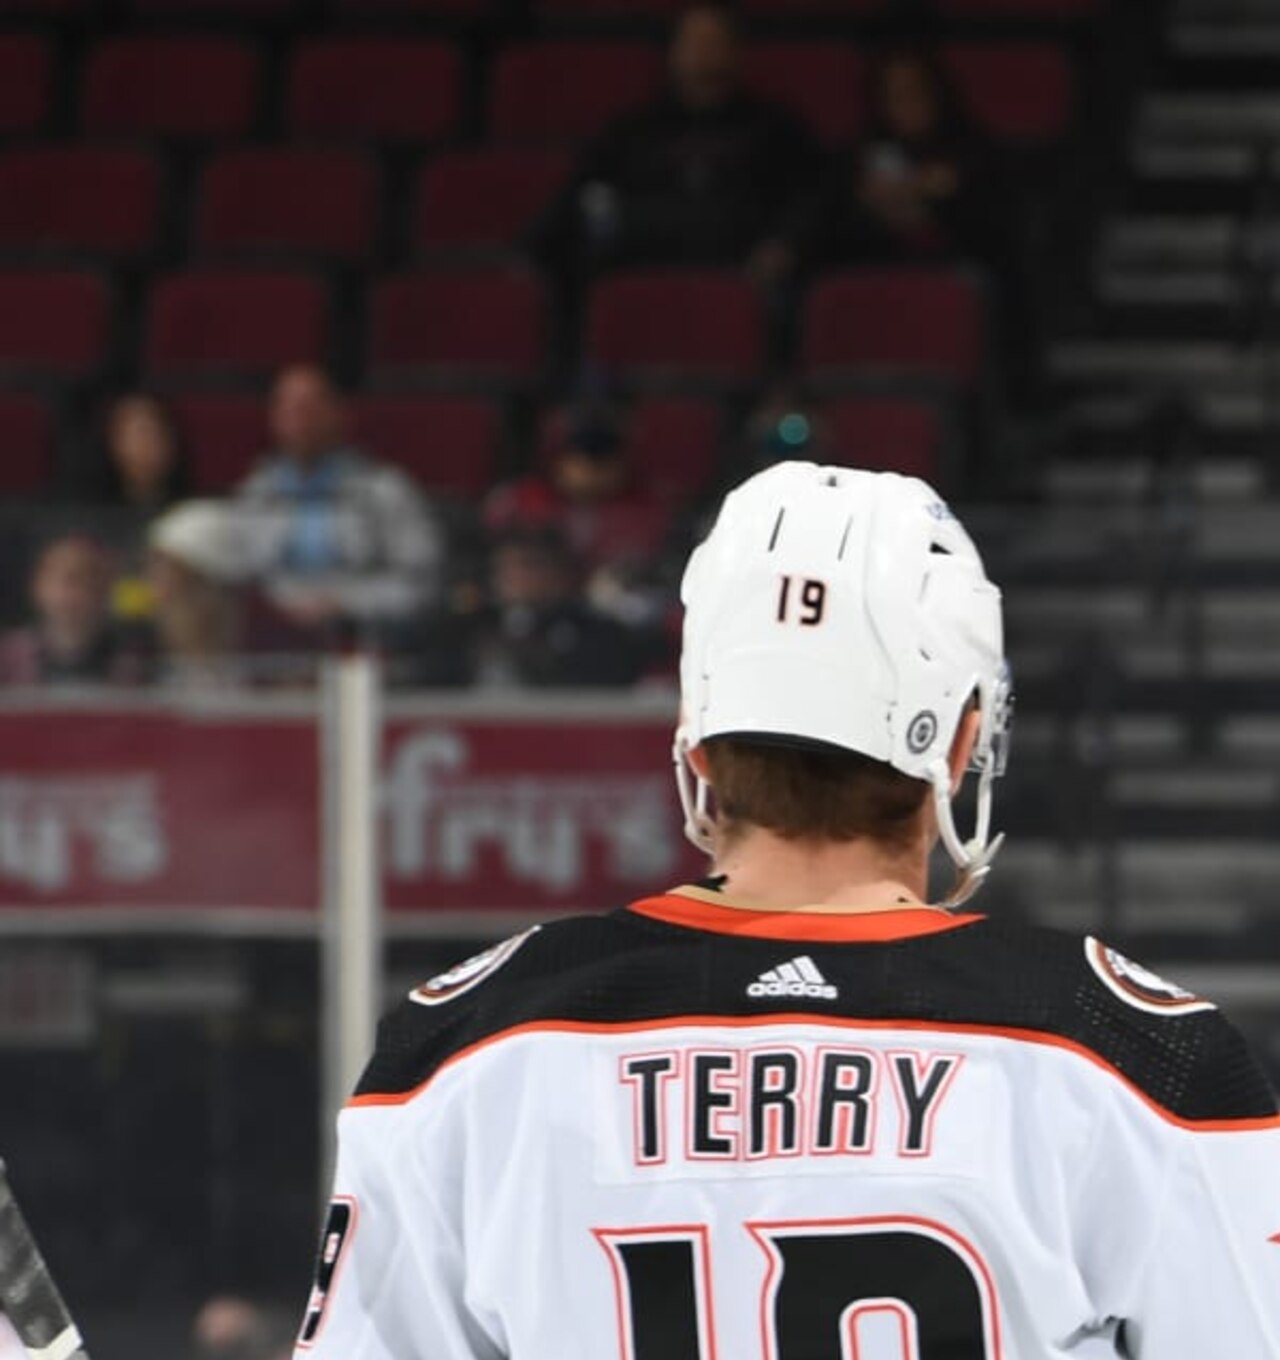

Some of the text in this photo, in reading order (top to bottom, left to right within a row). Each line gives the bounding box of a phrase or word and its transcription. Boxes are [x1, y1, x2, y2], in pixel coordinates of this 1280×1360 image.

[774, 573, 829, 628] 19
[378, 727, 676, 892] fry's
[747, 980, 838, 1000] adidas
[620, 1044, 965, 1167] TERRY
